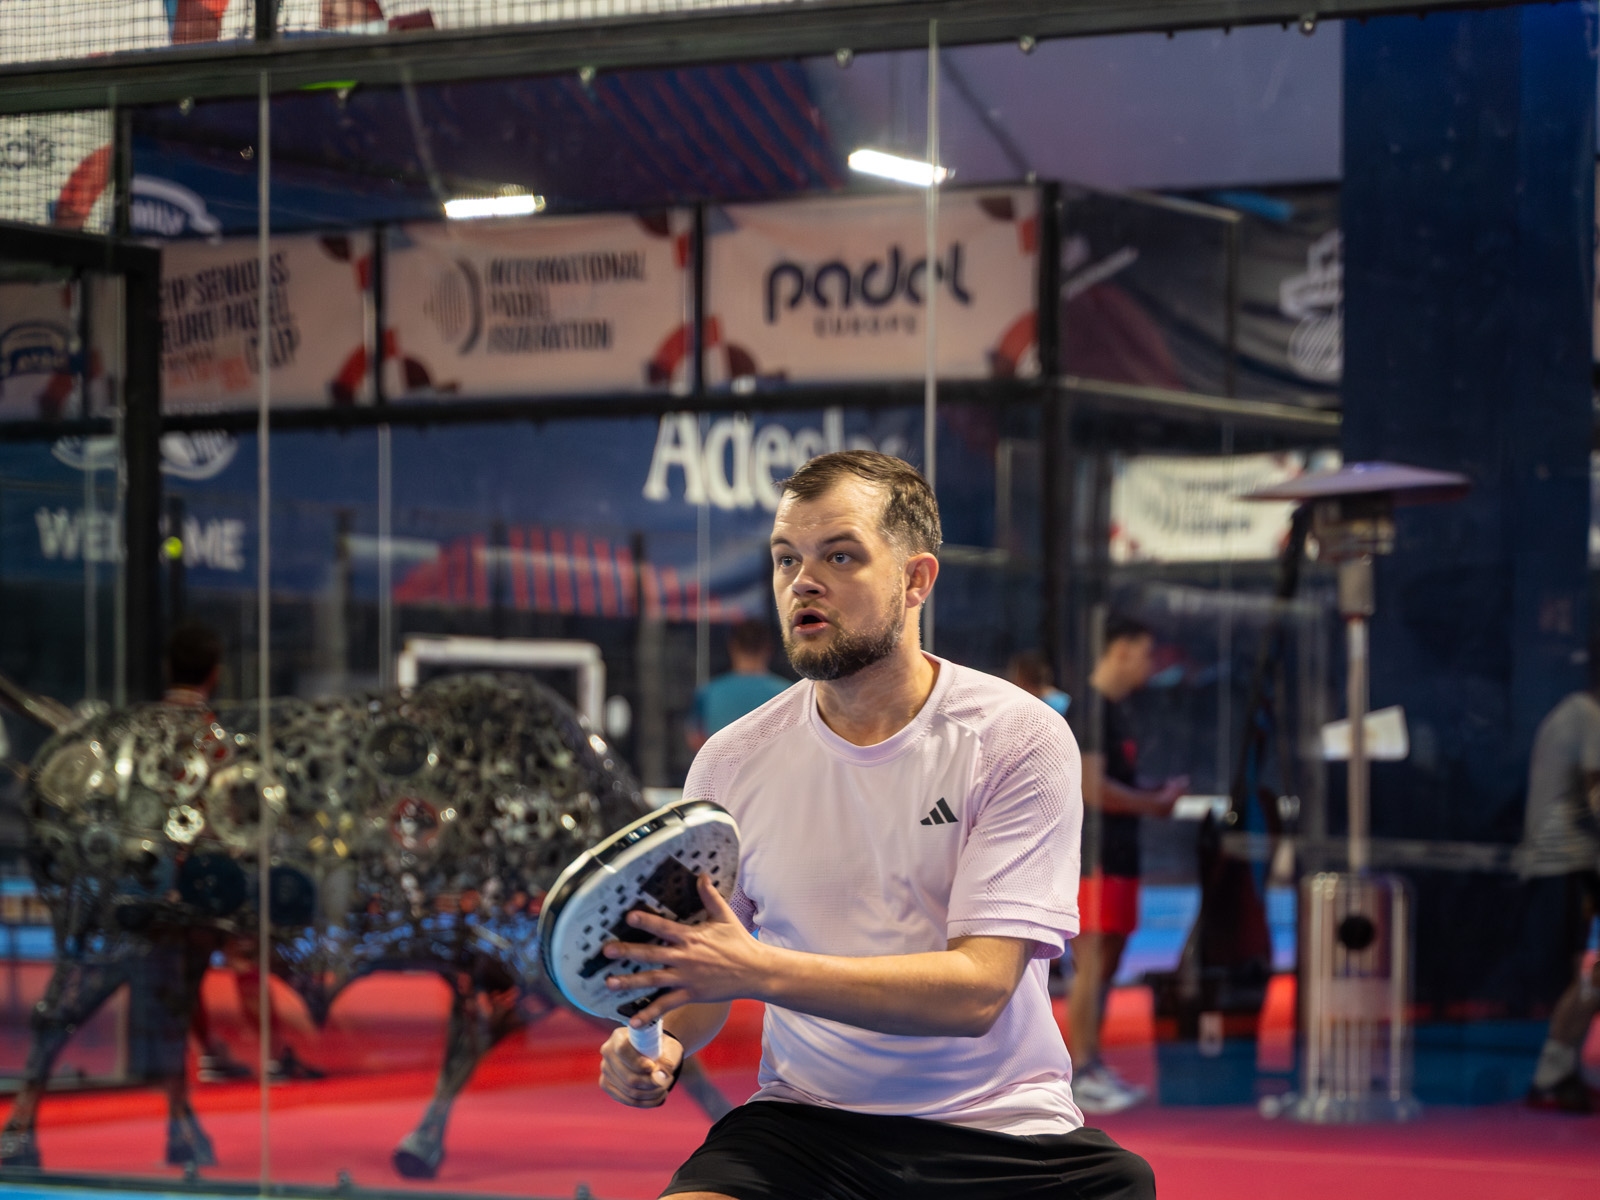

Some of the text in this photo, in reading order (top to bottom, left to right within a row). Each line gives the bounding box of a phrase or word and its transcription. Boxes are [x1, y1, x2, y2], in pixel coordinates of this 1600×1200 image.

[195, 251, 290, 307] SENIOS
[763, 240, 974, 326] padel
[222, 294, 292, 338] PADL
[34, 506, 246, 572] WELME
